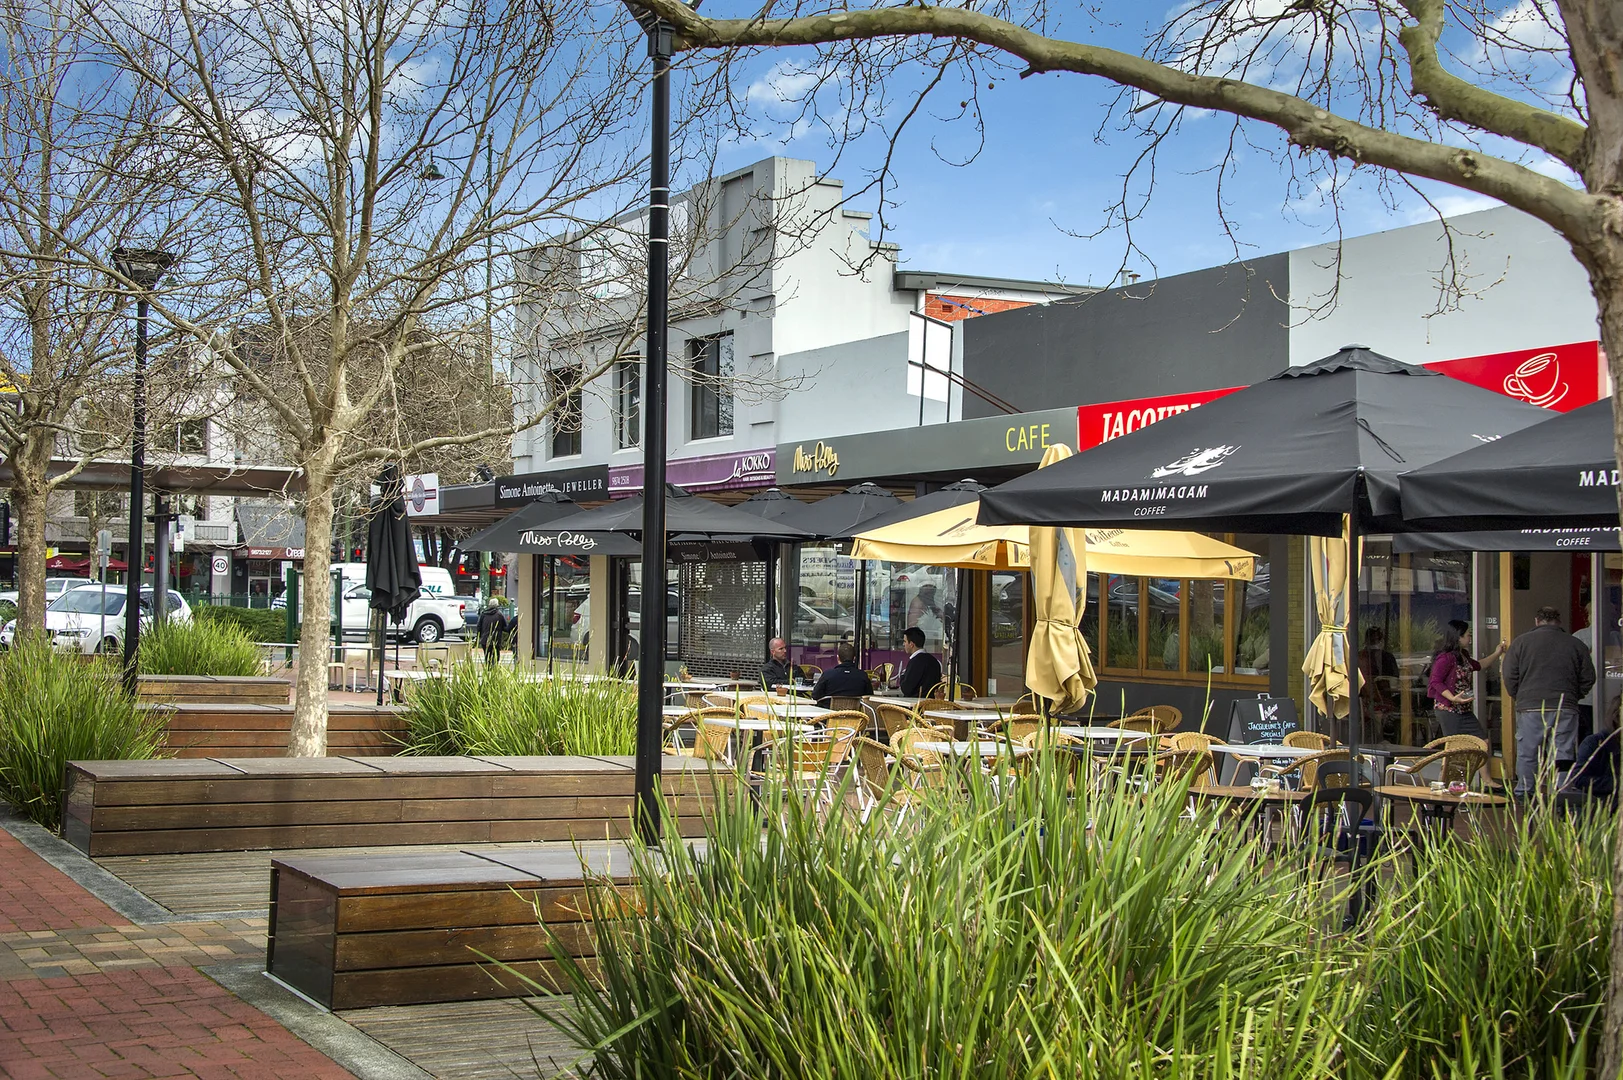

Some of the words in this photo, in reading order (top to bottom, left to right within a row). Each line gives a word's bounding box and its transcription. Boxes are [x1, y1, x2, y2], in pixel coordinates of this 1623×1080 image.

[1006, 423, 1050, 452] CAFE
[741, 452, 771, 472] KOKKO
[793, 445, 816, 474] Miss
[815, 441, 840, 477] Polly
[499, 485, 521, 499] Simone
[521, 481, 556, 497] Antoinette
[562, 478, 603, 494] JEWELLER
[1100, 485, 1209, 503] MADAMIMADAM
[1133, 505, 1167, 517] COFFEE
[519, 530, 557, 546] Miss
[556, 530, 598, 550] Polly
[1555, 536, 1591, 547] COFFEE
